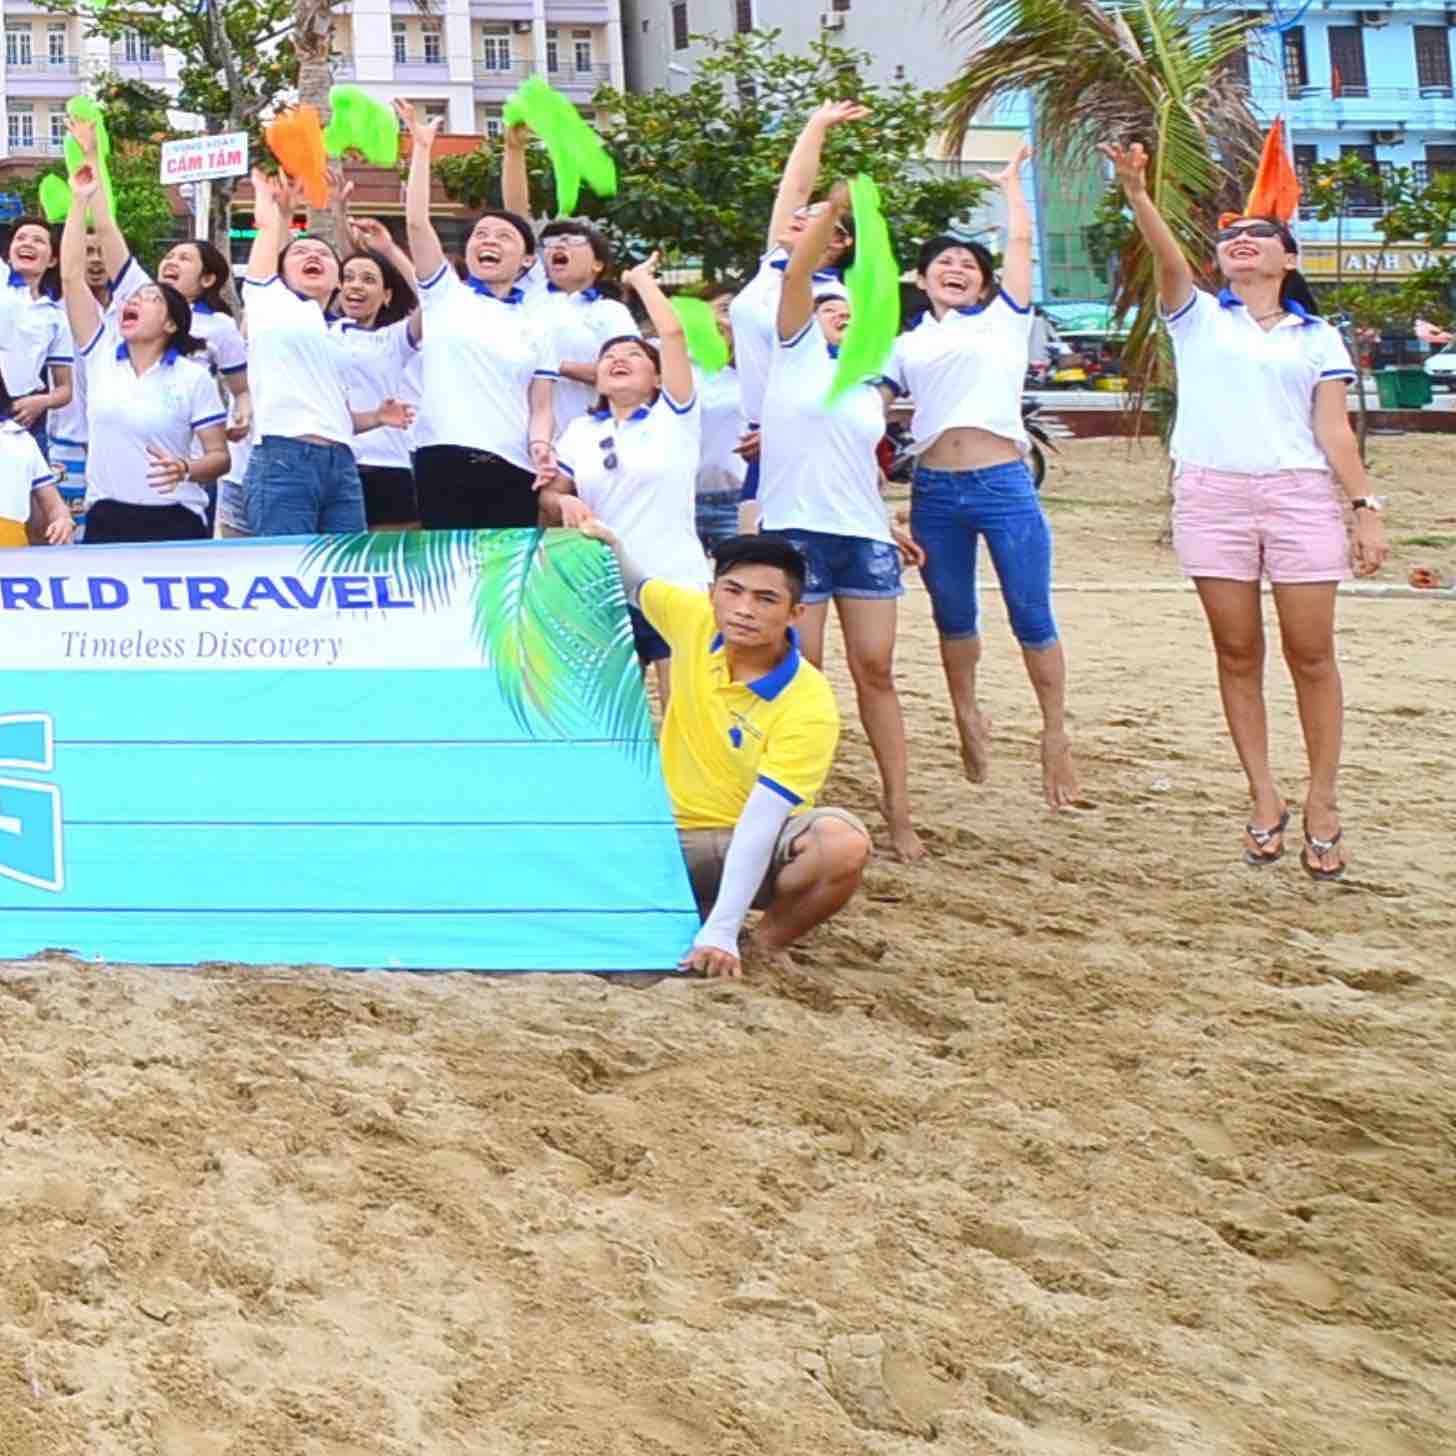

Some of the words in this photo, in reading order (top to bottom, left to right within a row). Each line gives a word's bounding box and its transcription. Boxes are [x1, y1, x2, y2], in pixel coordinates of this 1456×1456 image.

[142, 574, 416, 611] TRAVEL
[60, 630, 186, 660] Timeless
[195, 630, 344, 665] Discovery
